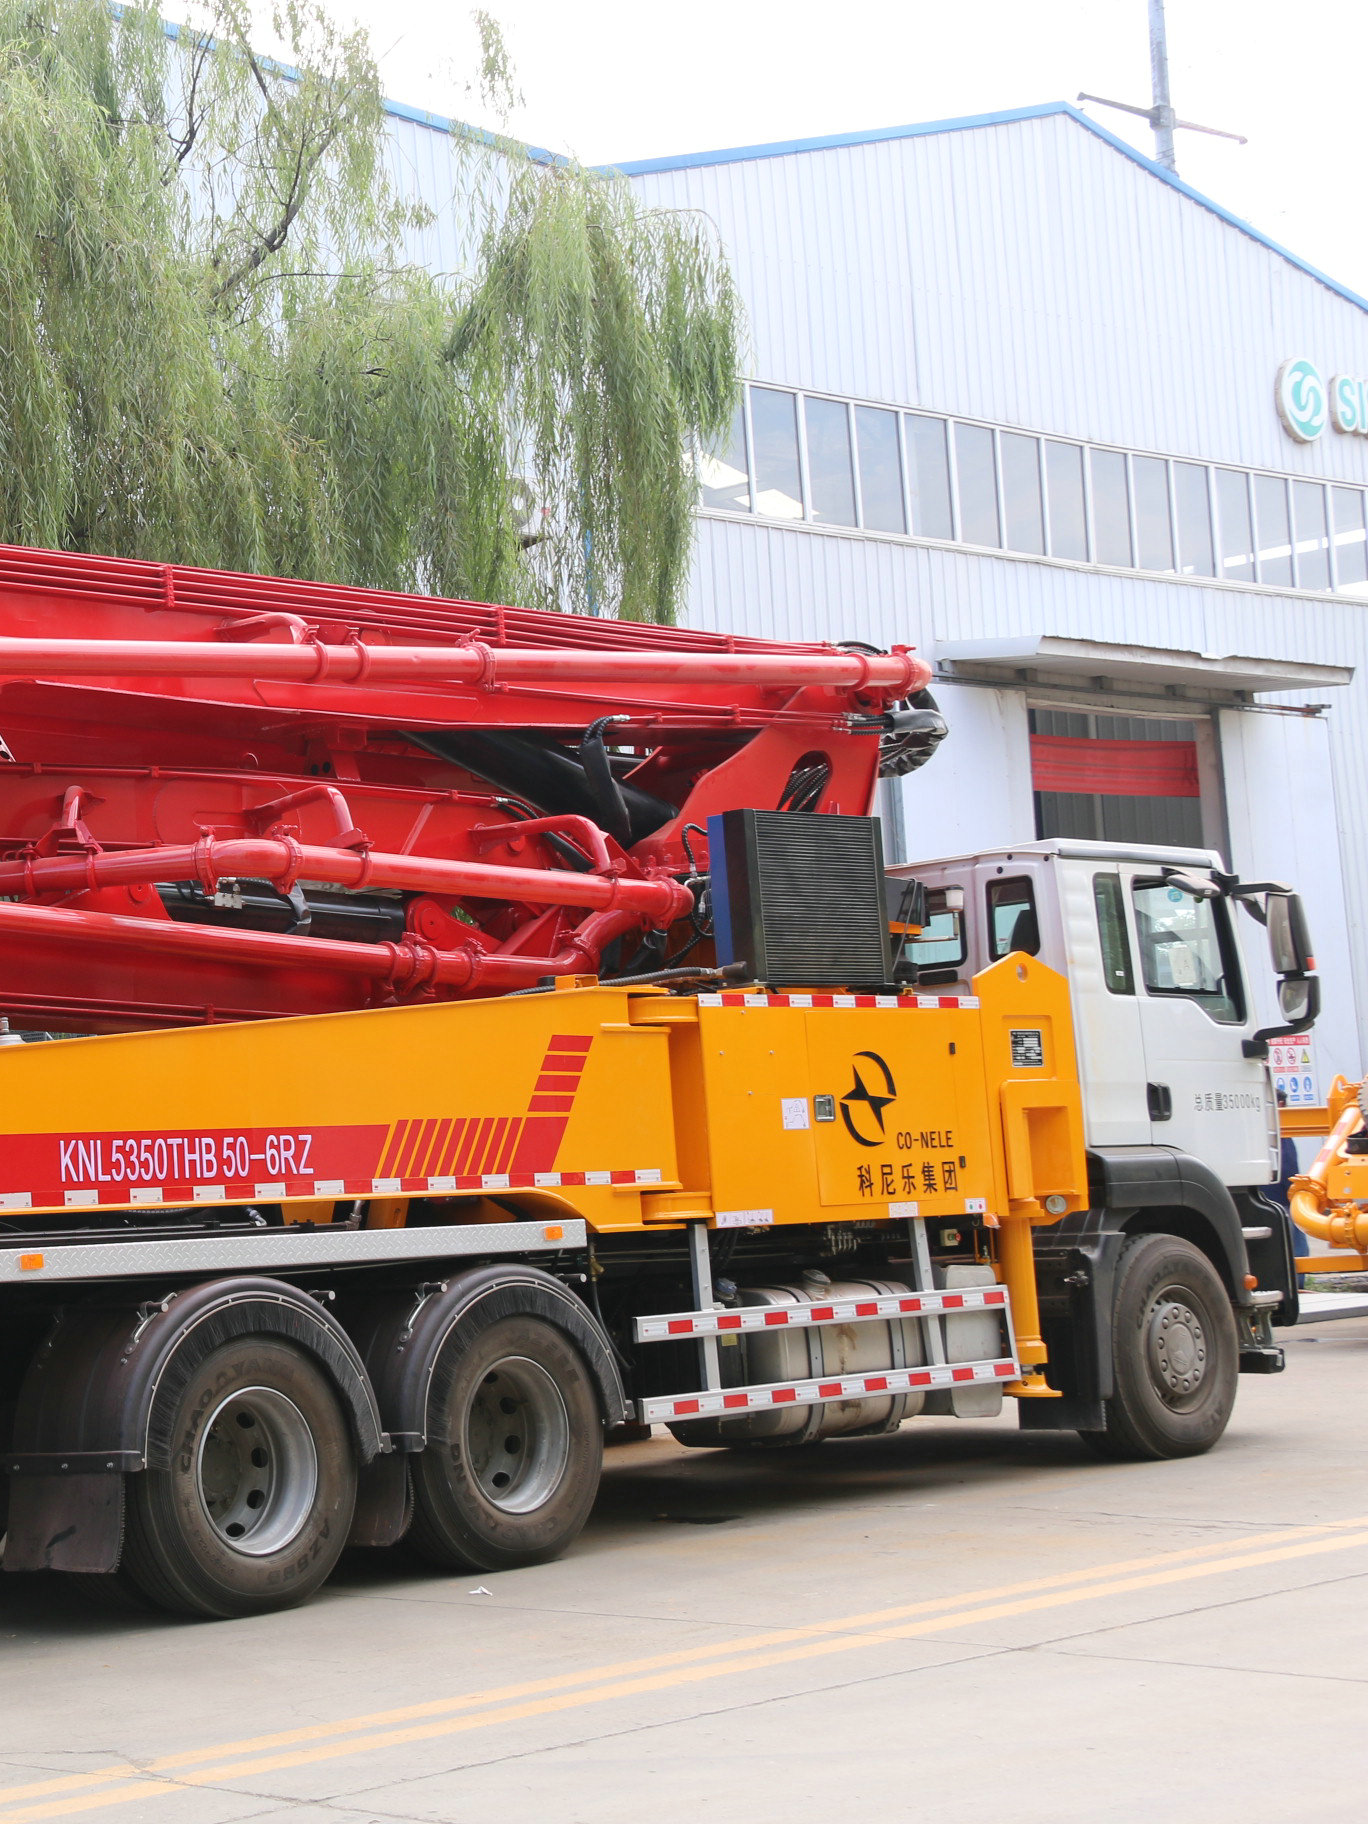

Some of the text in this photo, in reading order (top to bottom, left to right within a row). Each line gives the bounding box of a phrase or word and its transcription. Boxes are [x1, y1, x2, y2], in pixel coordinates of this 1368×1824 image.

[1336, 377, 1368, 431] SI
[896, 1130, 954, 1150] CO-NELE
[856, 1161, 959, 1198] 科尼乐集团
